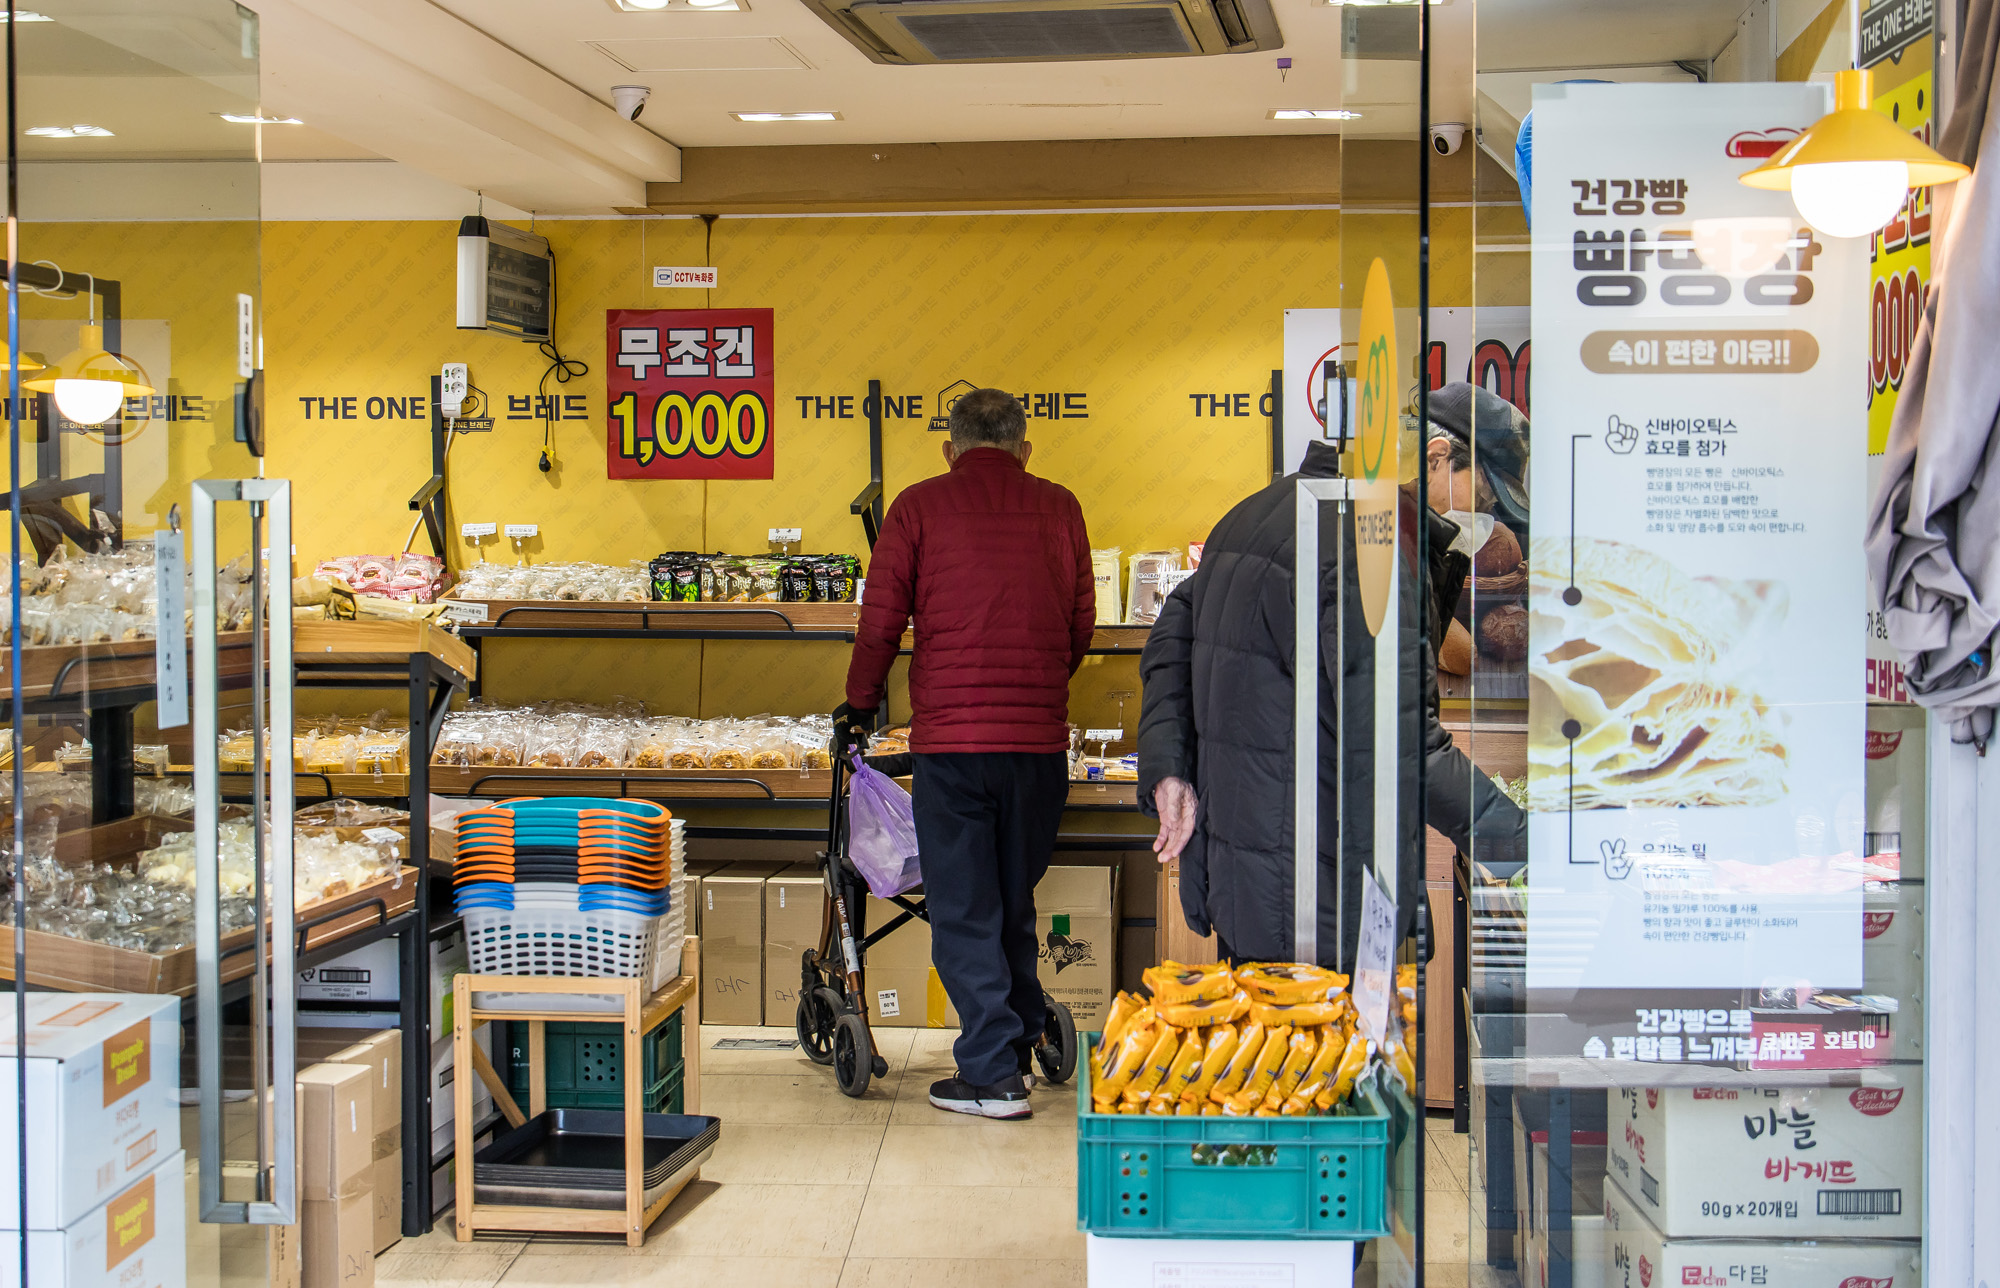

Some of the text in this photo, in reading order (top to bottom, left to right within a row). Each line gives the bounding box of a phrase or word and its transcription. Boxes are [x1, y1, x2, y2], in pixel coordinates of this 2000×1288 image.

[1862, 20, 1881, 54] THE
[1883, 6, 1902, 42] ONE
[1571, 179, 1688, 216] 건강빵
[674, 272, 714, 283] CCTV녹화중
[1573, 228, 1822, 306] 빵명장
[617, 326, 755, 379] 무조건
[1608, 340, 1790, 366] 속이 편한 이유!!
[124, 395, 205, 422] 브레드
[299, 394, 589, 421] THE ONE 브레드
[796, 395, 854, 419] THE
[1189, 394, 1250, 417] THE
[609, 390, 769, 467] 1,000
[932, 420, 948, 428] THE
[1645, 418, 1738, 435] 신바이오틱스
[1645, 439, 1727, 456] 효모를 첨가
[1685, 467, 1702, 477] 모든
[1705, 467, 1723, 477] 빵은
[1731, 467, 1785, 477] 신바이오틱스
[1646, 481, 1672, 491] 효모를
[1676, 481, 1711, 491] 첨가하여
[1646, 495, 1758, 505] 신바이오틱스 효모를 배합한
[1646, 509, 1778, 519] 빵명장은 차별화된 담백한 맛으로
[1357, 515, 1368, 545] THE
[1368, 513, 1378, 545] ONE
[1646, 523, 1664, 533] 소화
[1666, 523, 1675, 533] 및
[1677, 523, 1695, 533] 영양
[1698, 523, 1725, 533] 흡수를
[1728, 523, 1746, 533] 도와
[1748, 523, 1766, 533] 속이
[1643, 904, 1669, 914] 유기농
[1672, 904, 1698, 914] 밀가루
[1703, 904, 1737, 914] 100%를
[1643, 918, 1798, 928] 빵의 향과 맛이 좋고 글루텐이 소화되어
[1643, 931, 1660, 941] 속이
[1664, 931, 1690, 941] 편안한
[1635, 1009, 1752, 1033] 건강빵으로
[1583, 1036, 1607, 1060] 속
[1612, 1036, 1682, 1061] 편함을
[1855, 1101, 1896, 1111] Selection
[1857, 1089, 1878, 1100] Best
[1744, 1107, 1817, 1150] 마늘
[1764, 1156, 1857, 1183] 바게뜨
